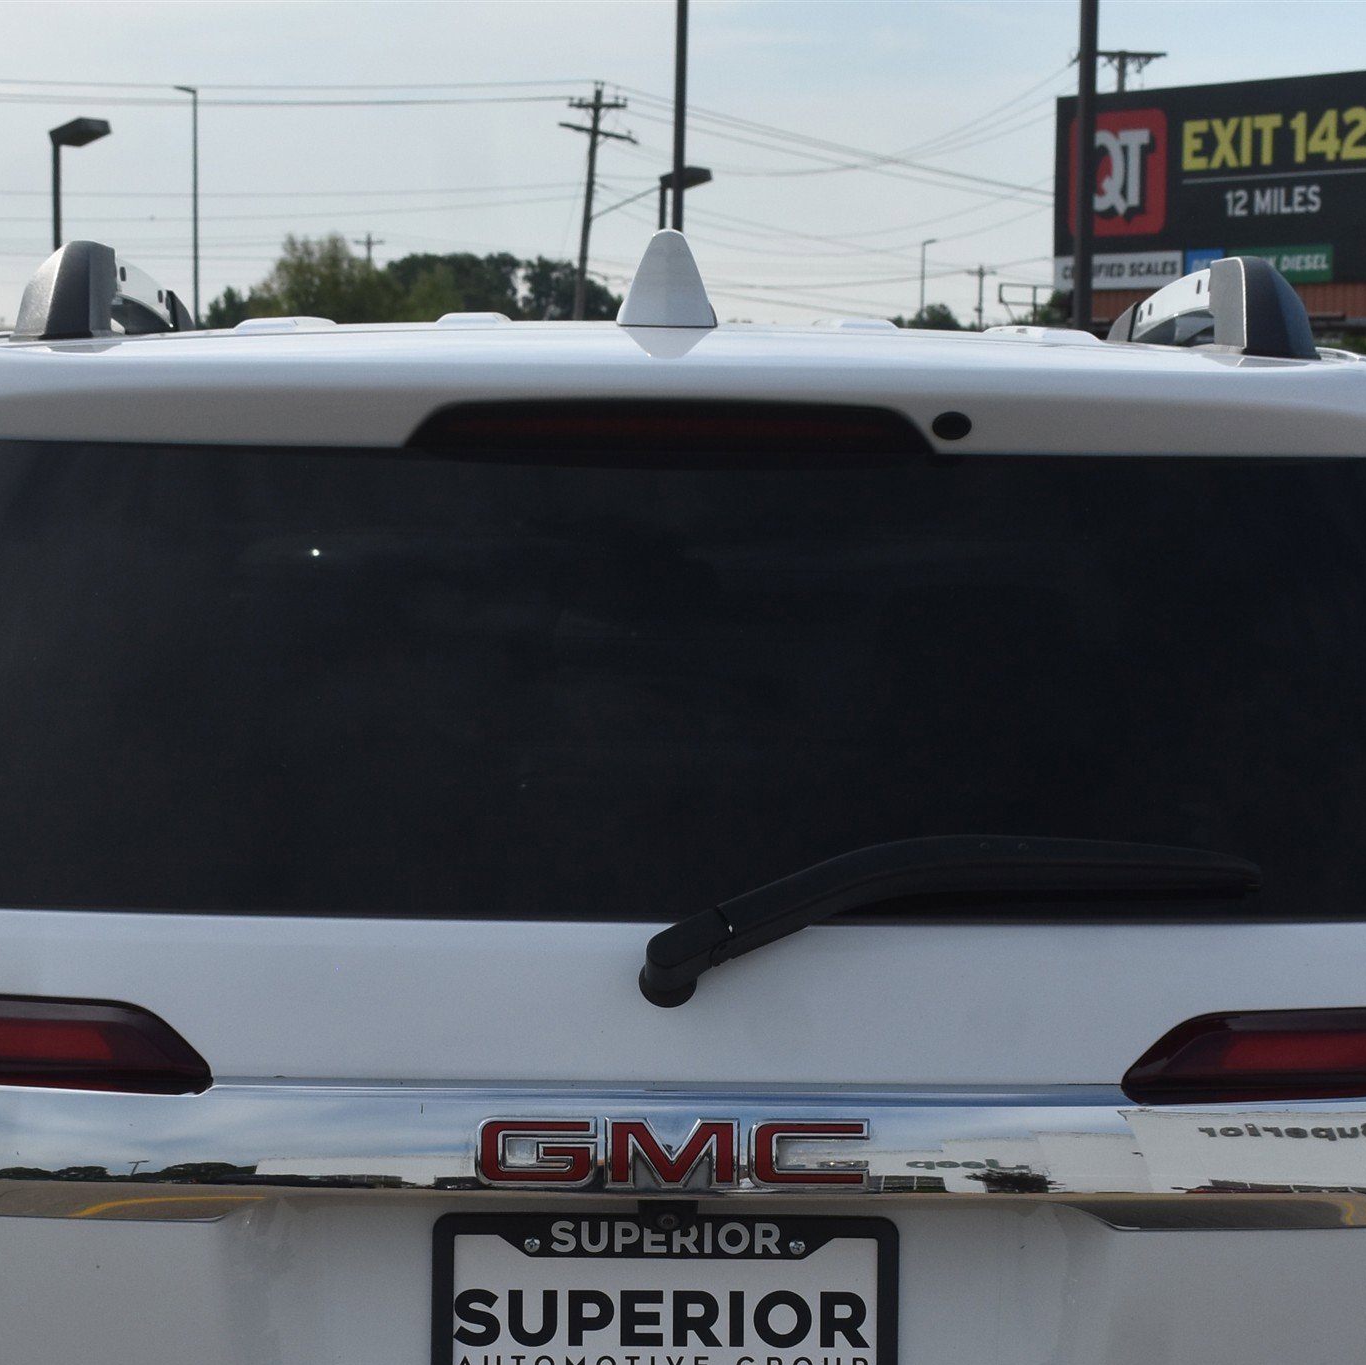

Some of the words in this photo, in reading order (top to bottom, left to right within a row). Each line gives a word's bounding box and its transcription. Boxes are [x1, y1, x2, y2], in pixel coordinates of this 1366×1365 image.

[1182, 113, 1283, 172] EXIT
[1093, 128, 1150, 217] QT
[1225, 189, 1248, 217] 12
[1253, 185, 1322, 216] MILES
[1133, 260, 1179, 278] SCALES
[1280, 253, 1329, 272] DIESEL
[476, 1116, 870, 1190] GMC
[549, 1220, 781, 1255] SUPERIOR
[453, 1288, 870, 1349] SUPERIOR
